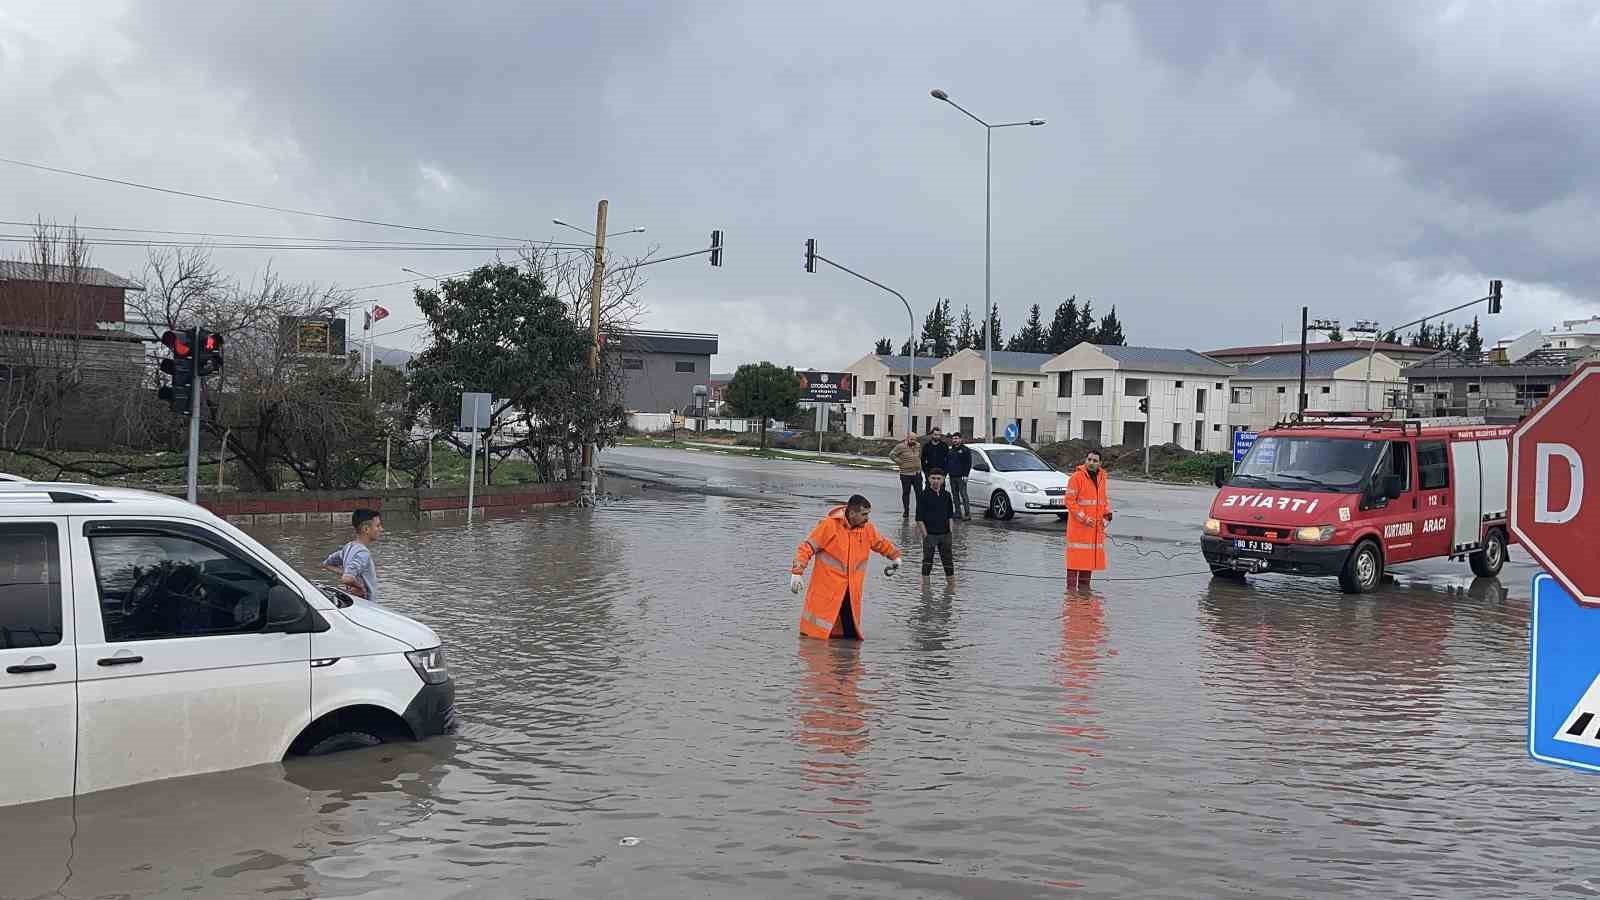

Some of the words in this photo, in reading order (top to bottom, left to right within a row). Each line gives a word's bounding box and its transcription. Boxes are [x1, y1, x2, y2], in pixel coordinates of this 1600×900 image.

[1428, 495, 1438, 506] 112
[1384, 521, 1413, 539] KURTARMA
[1422, 517, 1447, 534] ARACI
